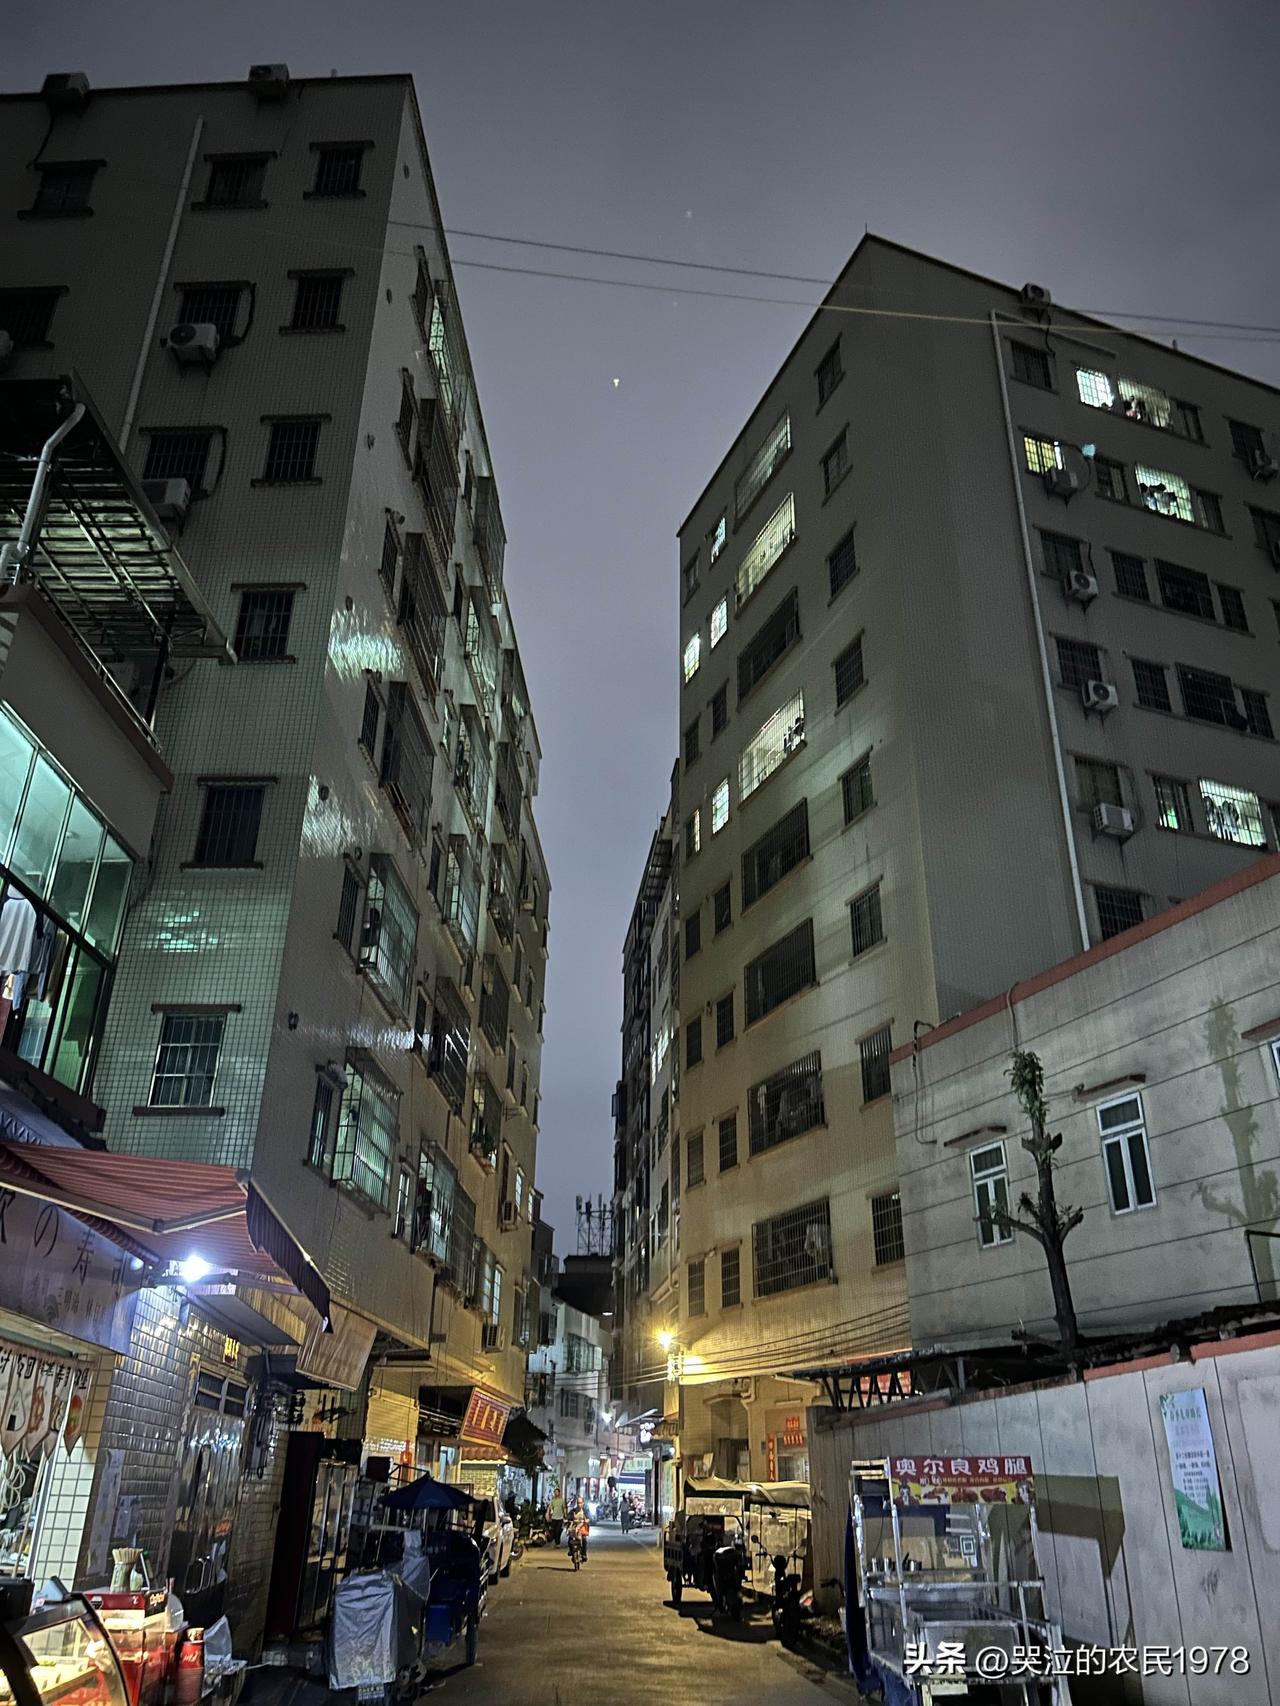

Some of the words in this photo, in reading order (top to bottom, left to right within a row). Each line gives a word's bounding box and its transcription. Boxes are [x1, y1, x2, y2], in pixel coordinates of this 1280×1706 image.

[896, 1458, 1028, 1476] 奥尔良鸡腿
